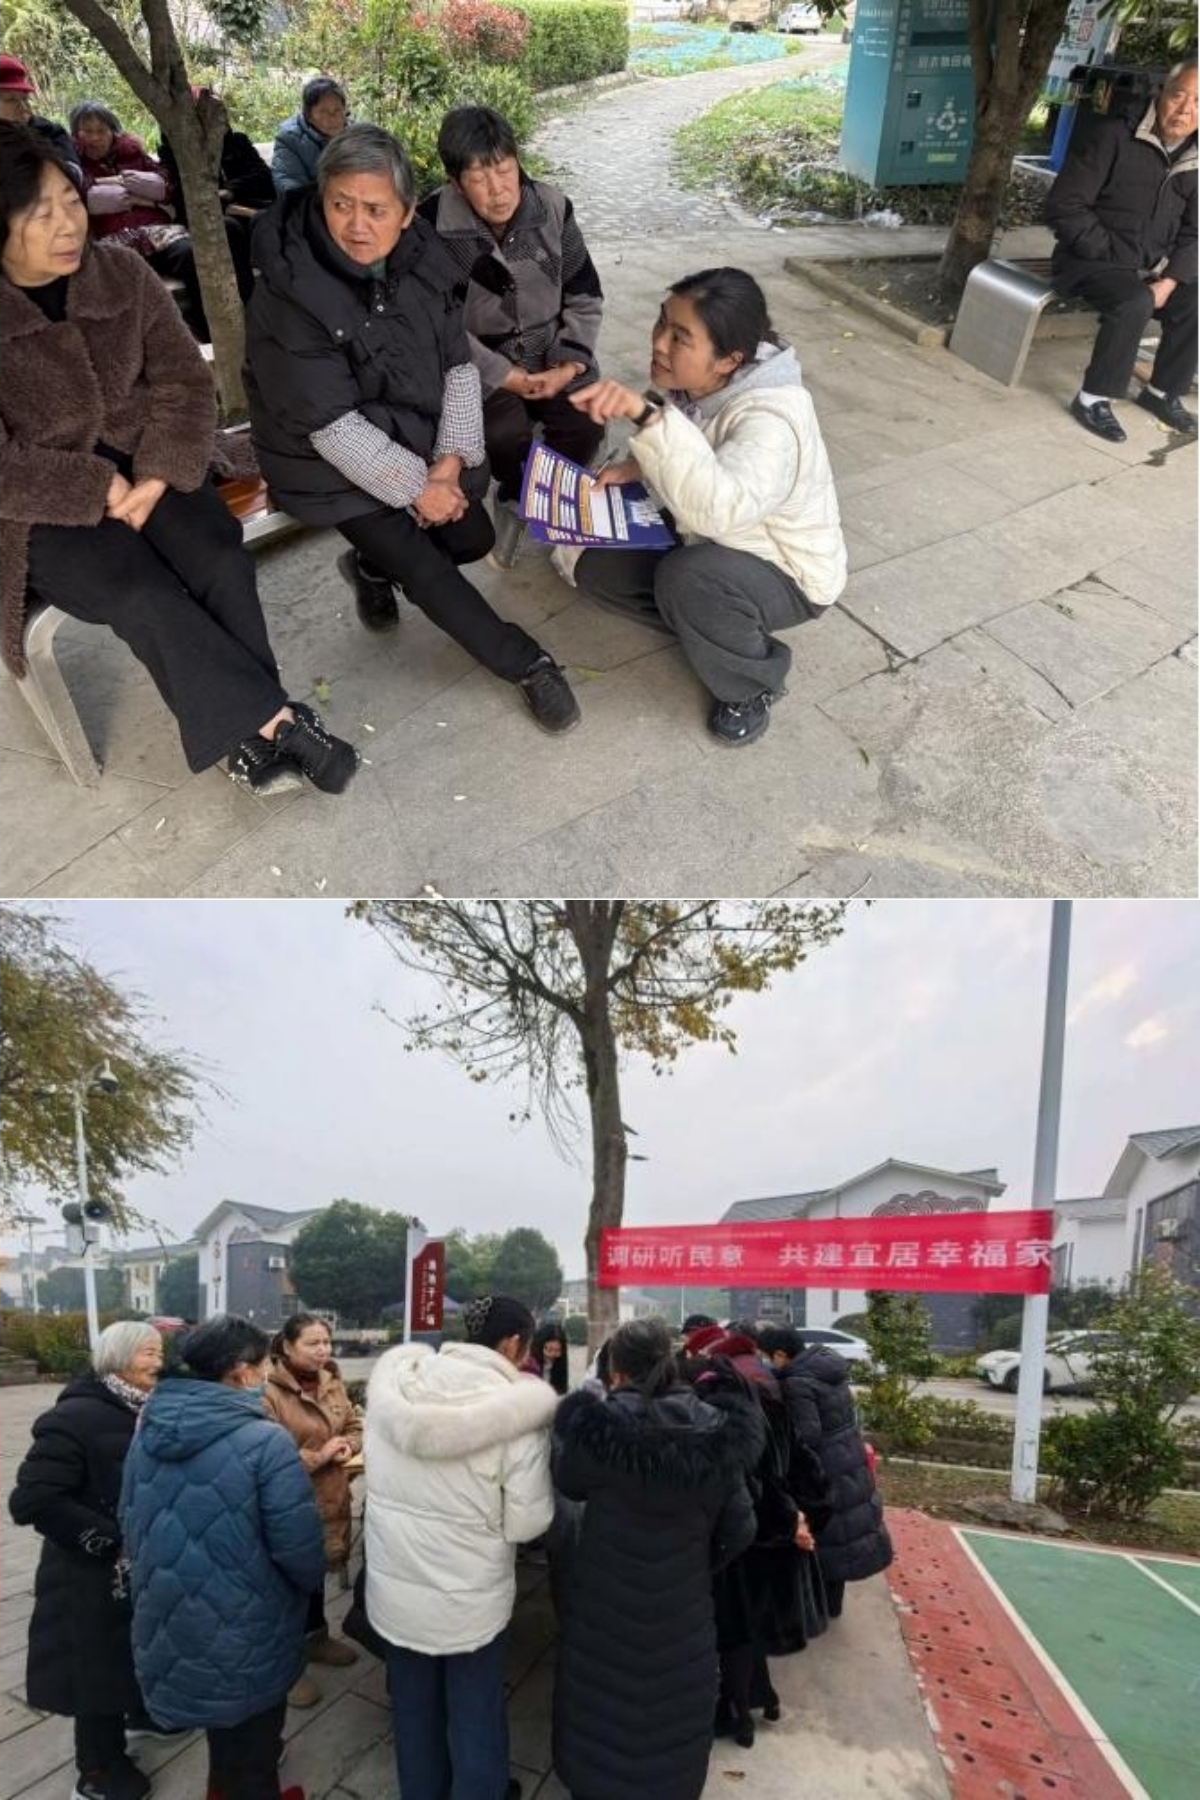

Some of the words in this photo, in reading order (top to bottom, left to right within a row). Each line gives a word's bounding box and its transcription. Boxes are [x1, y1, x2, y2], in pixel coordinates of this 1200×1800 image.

[607, 1244, 745, 1268] 调研听民意
[778, 1238, 1053, 1268] 共建宜居幸福家
